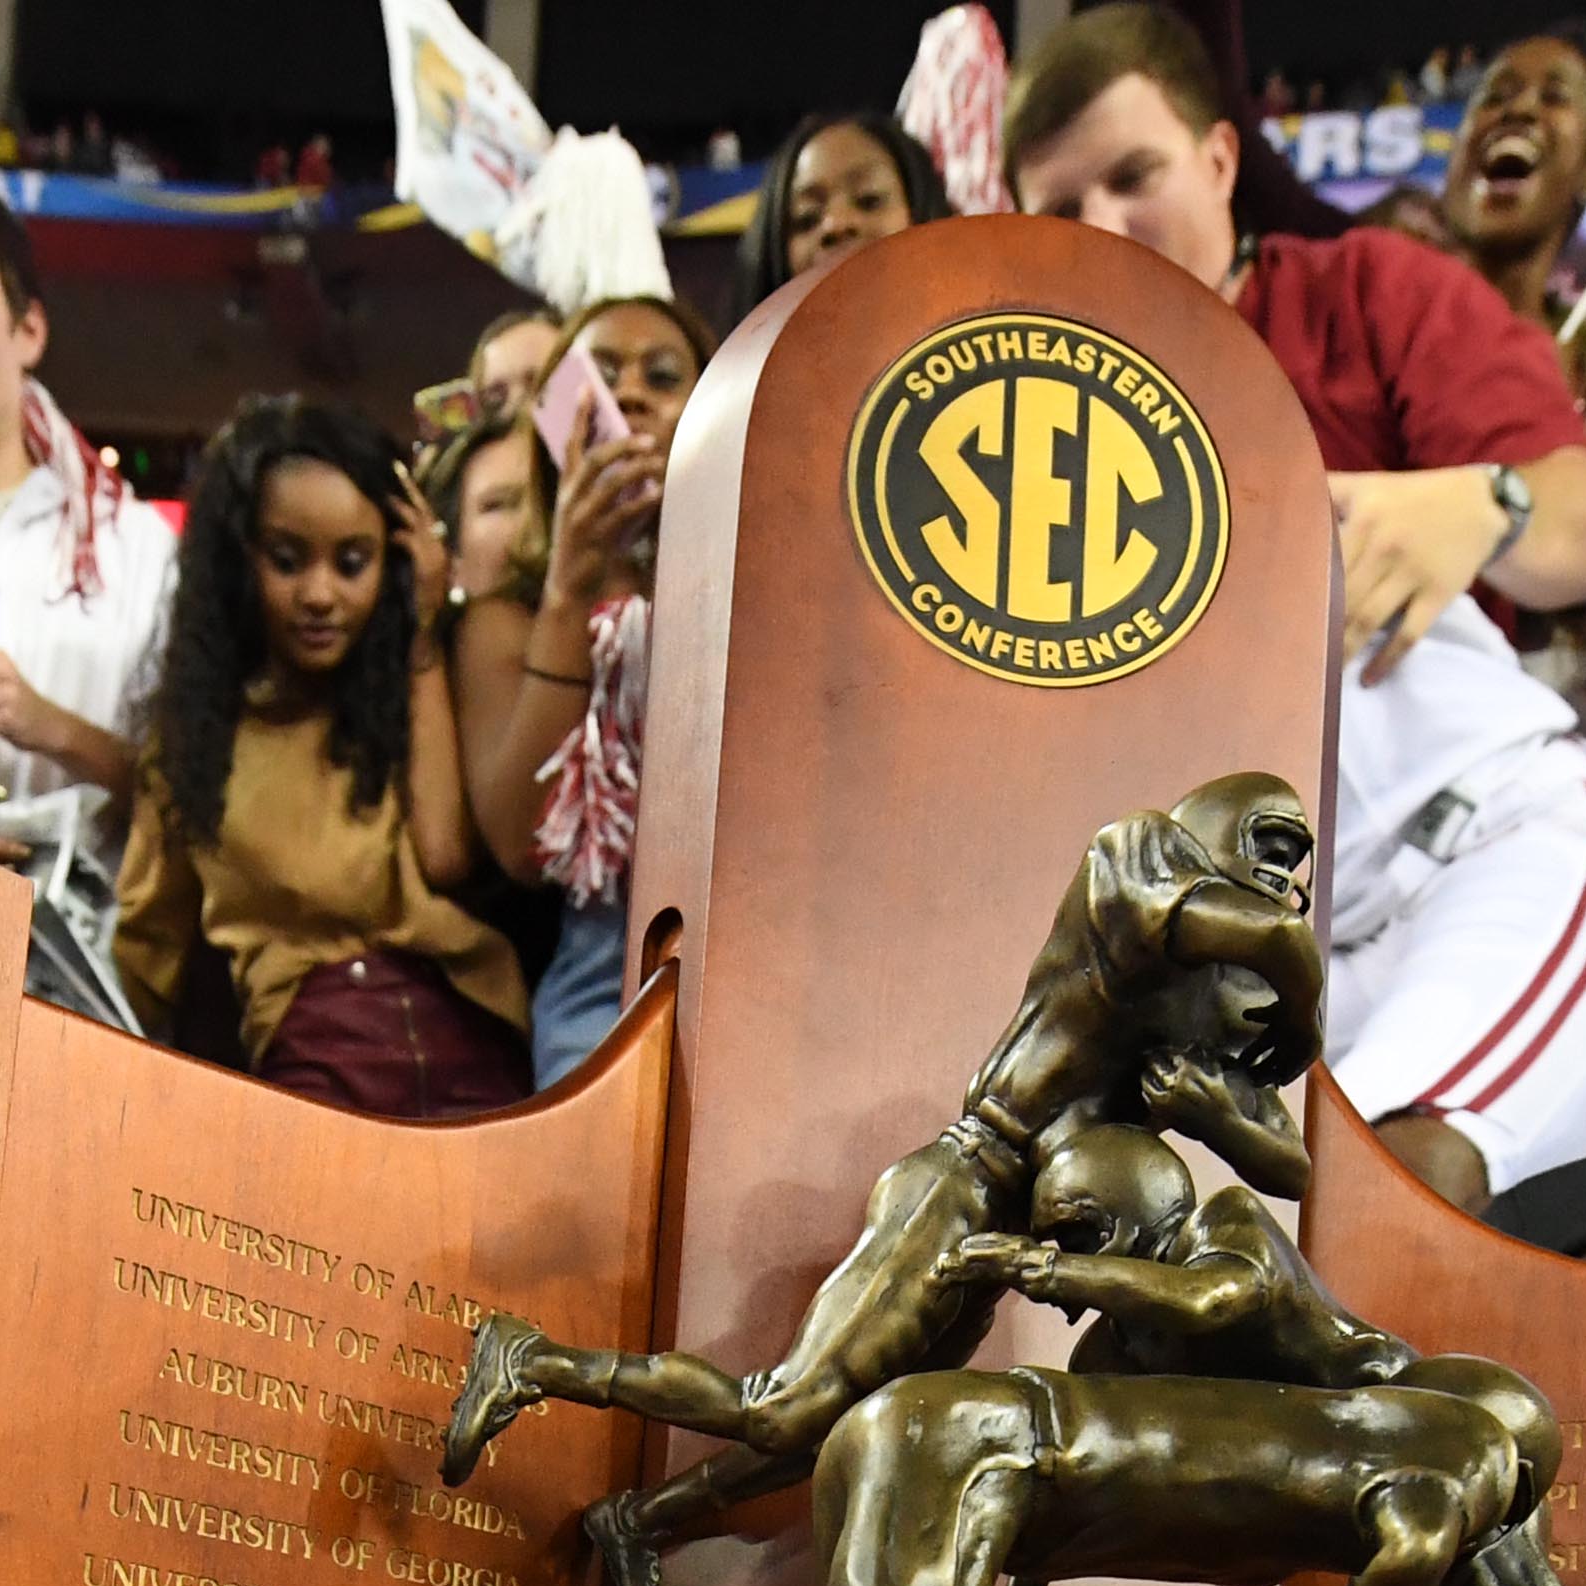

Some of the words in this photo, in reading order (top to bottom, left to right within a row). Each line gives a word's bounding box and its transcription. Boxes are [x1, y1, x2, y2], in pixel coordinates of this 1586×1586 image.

[905, 330, 1181, 436] SOUTHEASTERN
[918, 376, 1164, 623] SEC
[911, 584, 1164, 670] CONFERENCE
[112, 1256, 325, 1350] UNIVERSITY
[334, 1325, 380, 1365] OF
[131, 1187, 341, 1284] UNIVERSITY
[350, 1262, 395, 1300] OF
[403, 1280, 542, 1330] ALAB
[159, 1347, 308, 1416] AUBURN
[108, 1482, 320, 1560] UNIVERSITY
[331, 1535, 376, 1571] OF
[119, 1409, 329, 1490] UNIVERSITY
[339, 1467, 384, 1503] OF
[394, 1479, 526, 1541] FLORIDA
